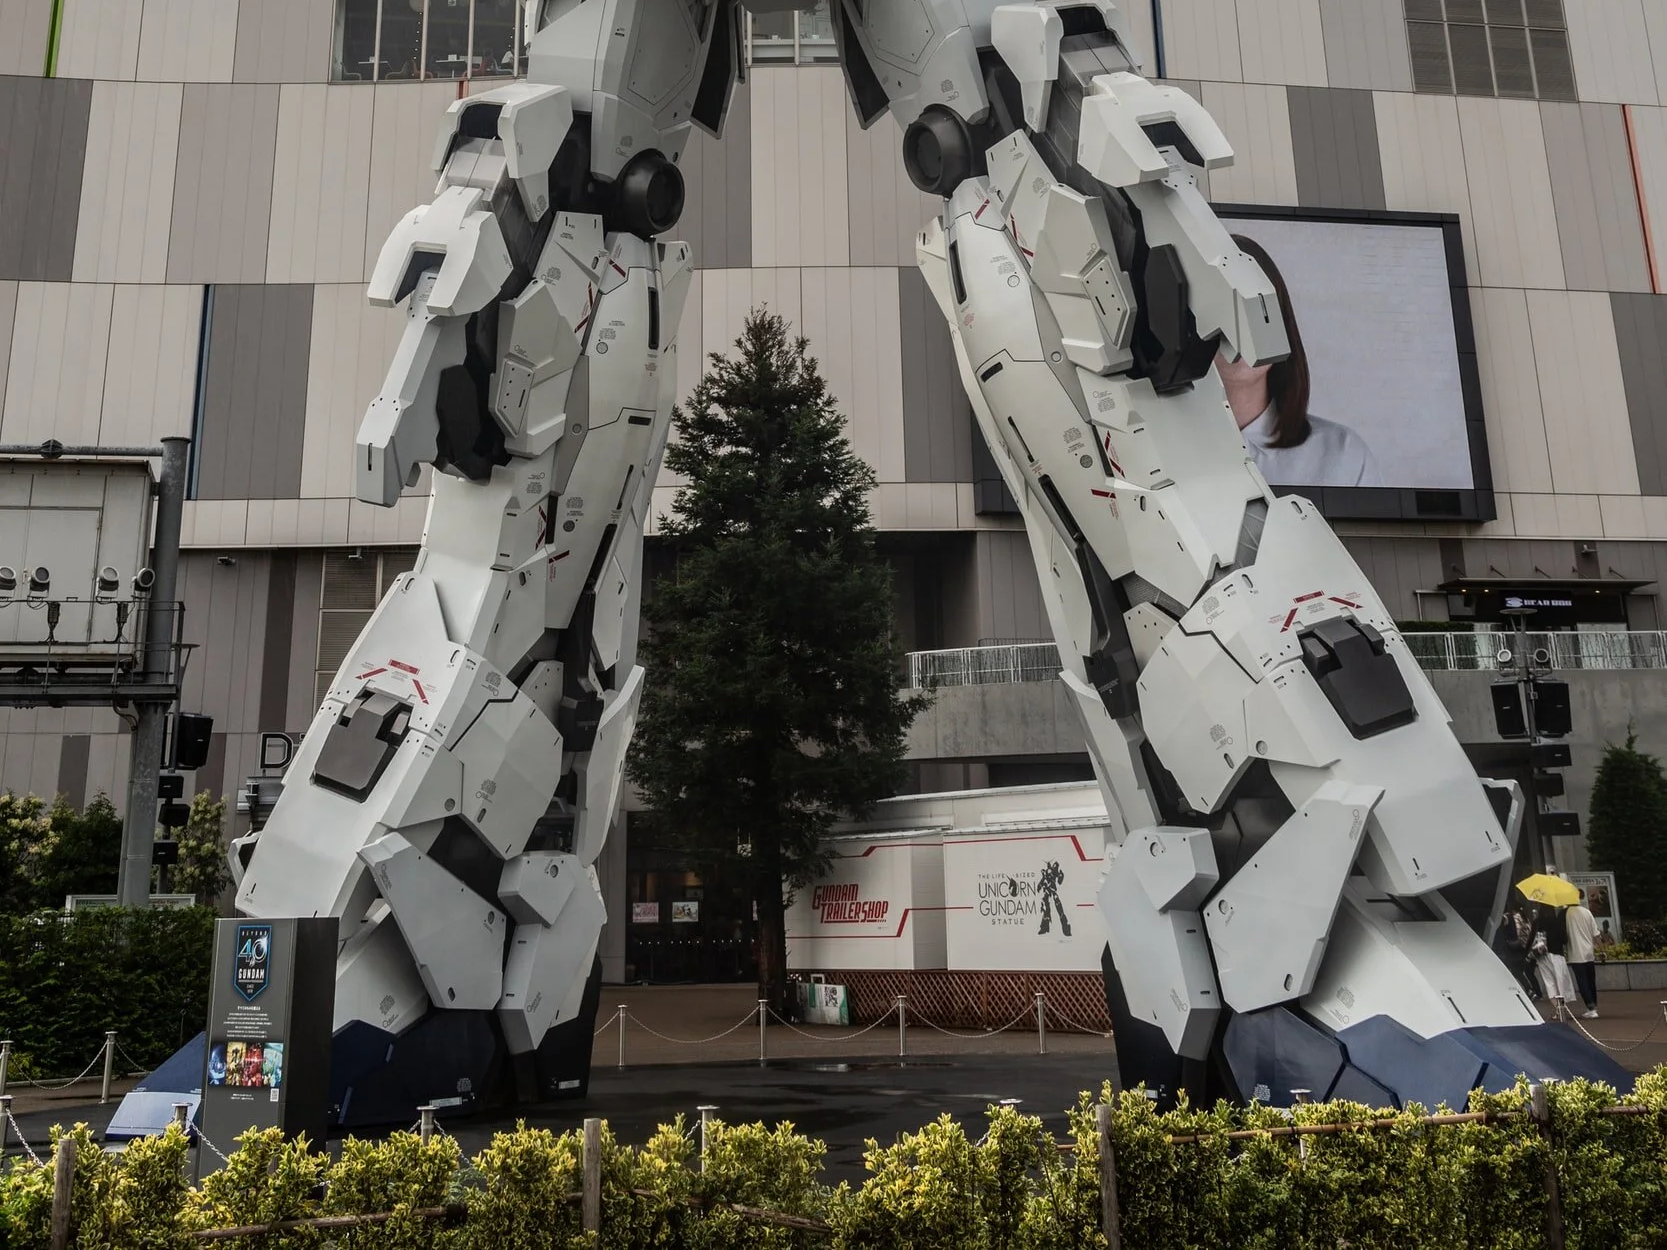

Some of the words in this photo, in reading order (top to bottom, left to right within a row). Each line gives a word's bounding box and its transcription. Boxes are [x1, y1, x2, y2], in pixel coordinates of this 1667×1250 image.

[812, 883, 859, 910] GUNDAM
[978, 881, 1037, 898] UNICORN
[979, 900, 1037, 916] GUNDAM
[238, 968, 265, 979] GUNDAM
